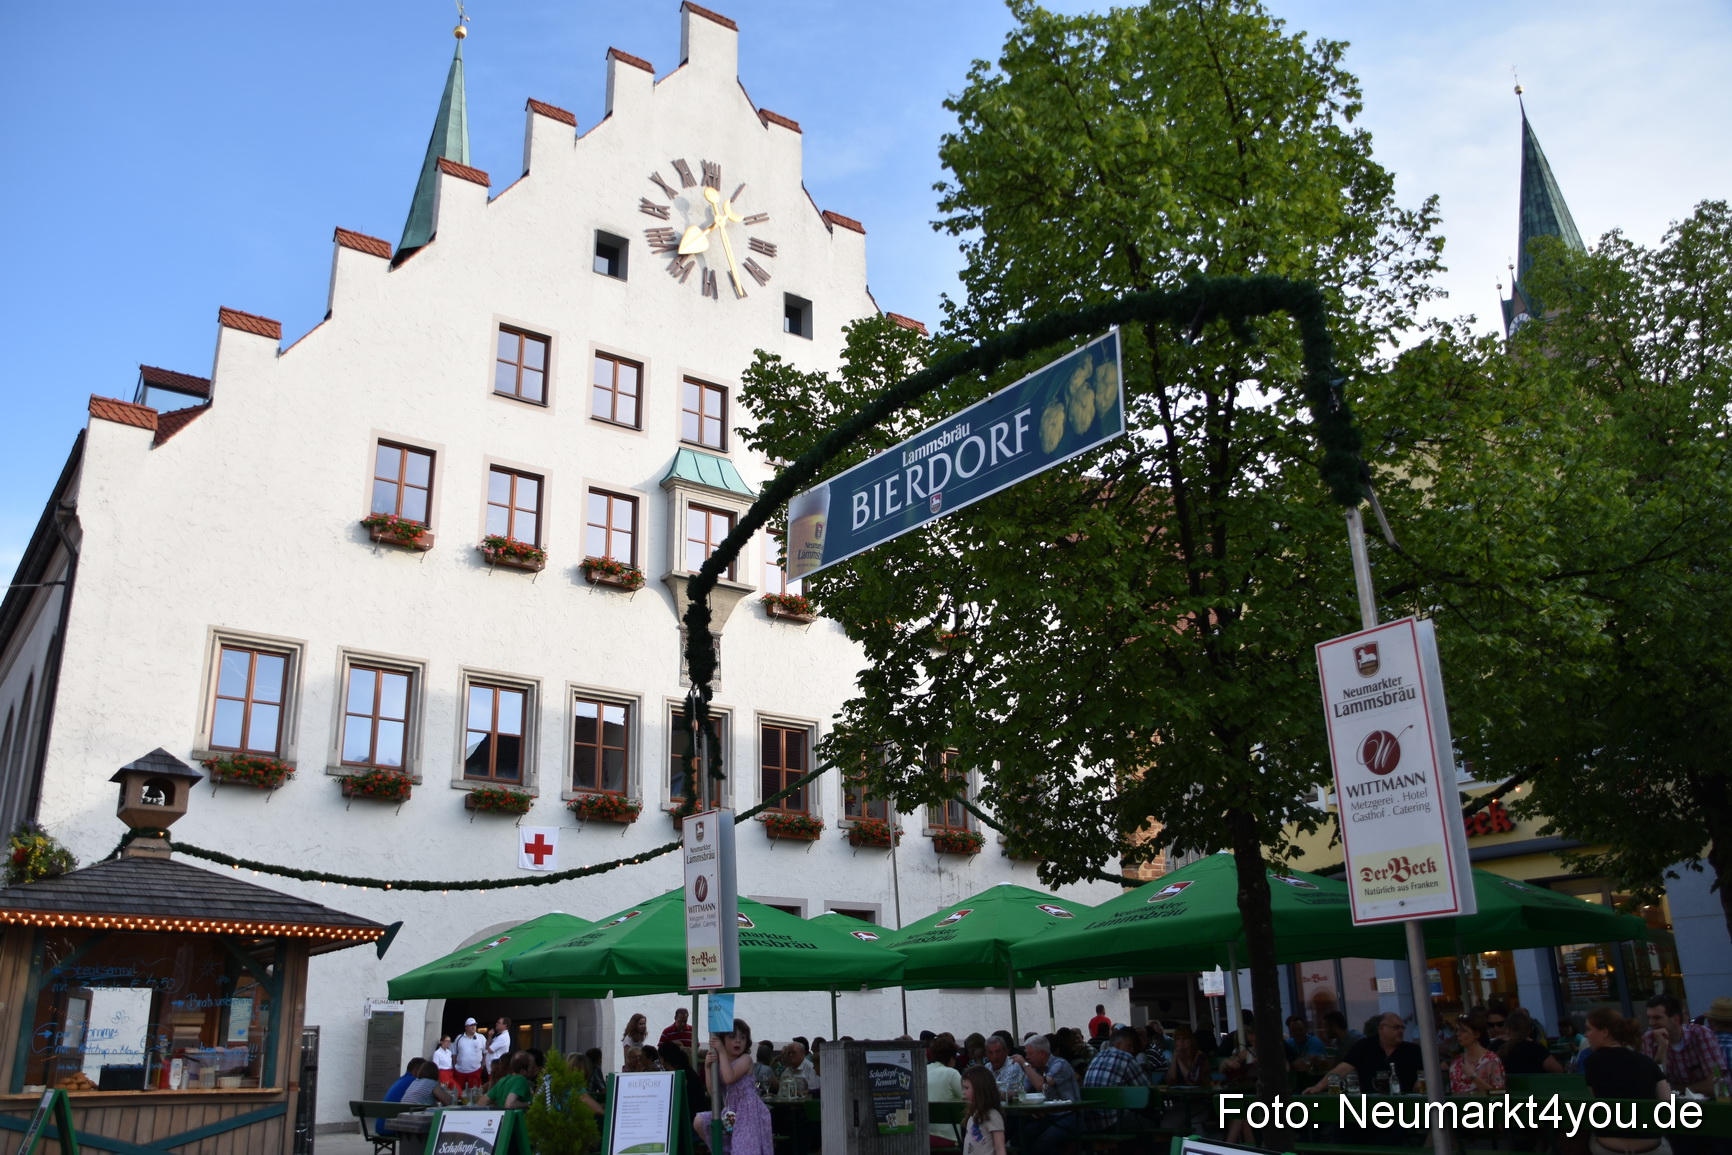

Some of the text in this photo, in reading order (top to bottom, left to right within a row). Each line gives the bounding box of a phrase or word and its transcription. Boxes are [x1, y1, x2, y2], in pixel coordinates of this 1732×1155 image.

[902, 421, 970, 468] Lammsbräu
[851, 408, 1032, 532] BIERDORF
[1343, 676, 1403, 700] Neumarkter
[1334, 686, 1417, 718] Lammsbräu
[1346, 771, 1427, 799] WITTMANN
[1350, 787, 1428, 812] Metzgerei Hotel
[1352, 801, 1431, 823] Gasthof Catering
[1464, 802, 1514, 837] eck
[686, 851, 715, 865] Lammsbräu
[690, 844, 712, 853] Neumarkter
[1364, 879, 1439, 896] Natürlich aus Franken
[688, 902, 716, 914] WITTMANN
[703, 920, 717, 928] Catering
[739, 931, 793, 941] markter
[627, 1080, 661, 1088] BIERDORF
